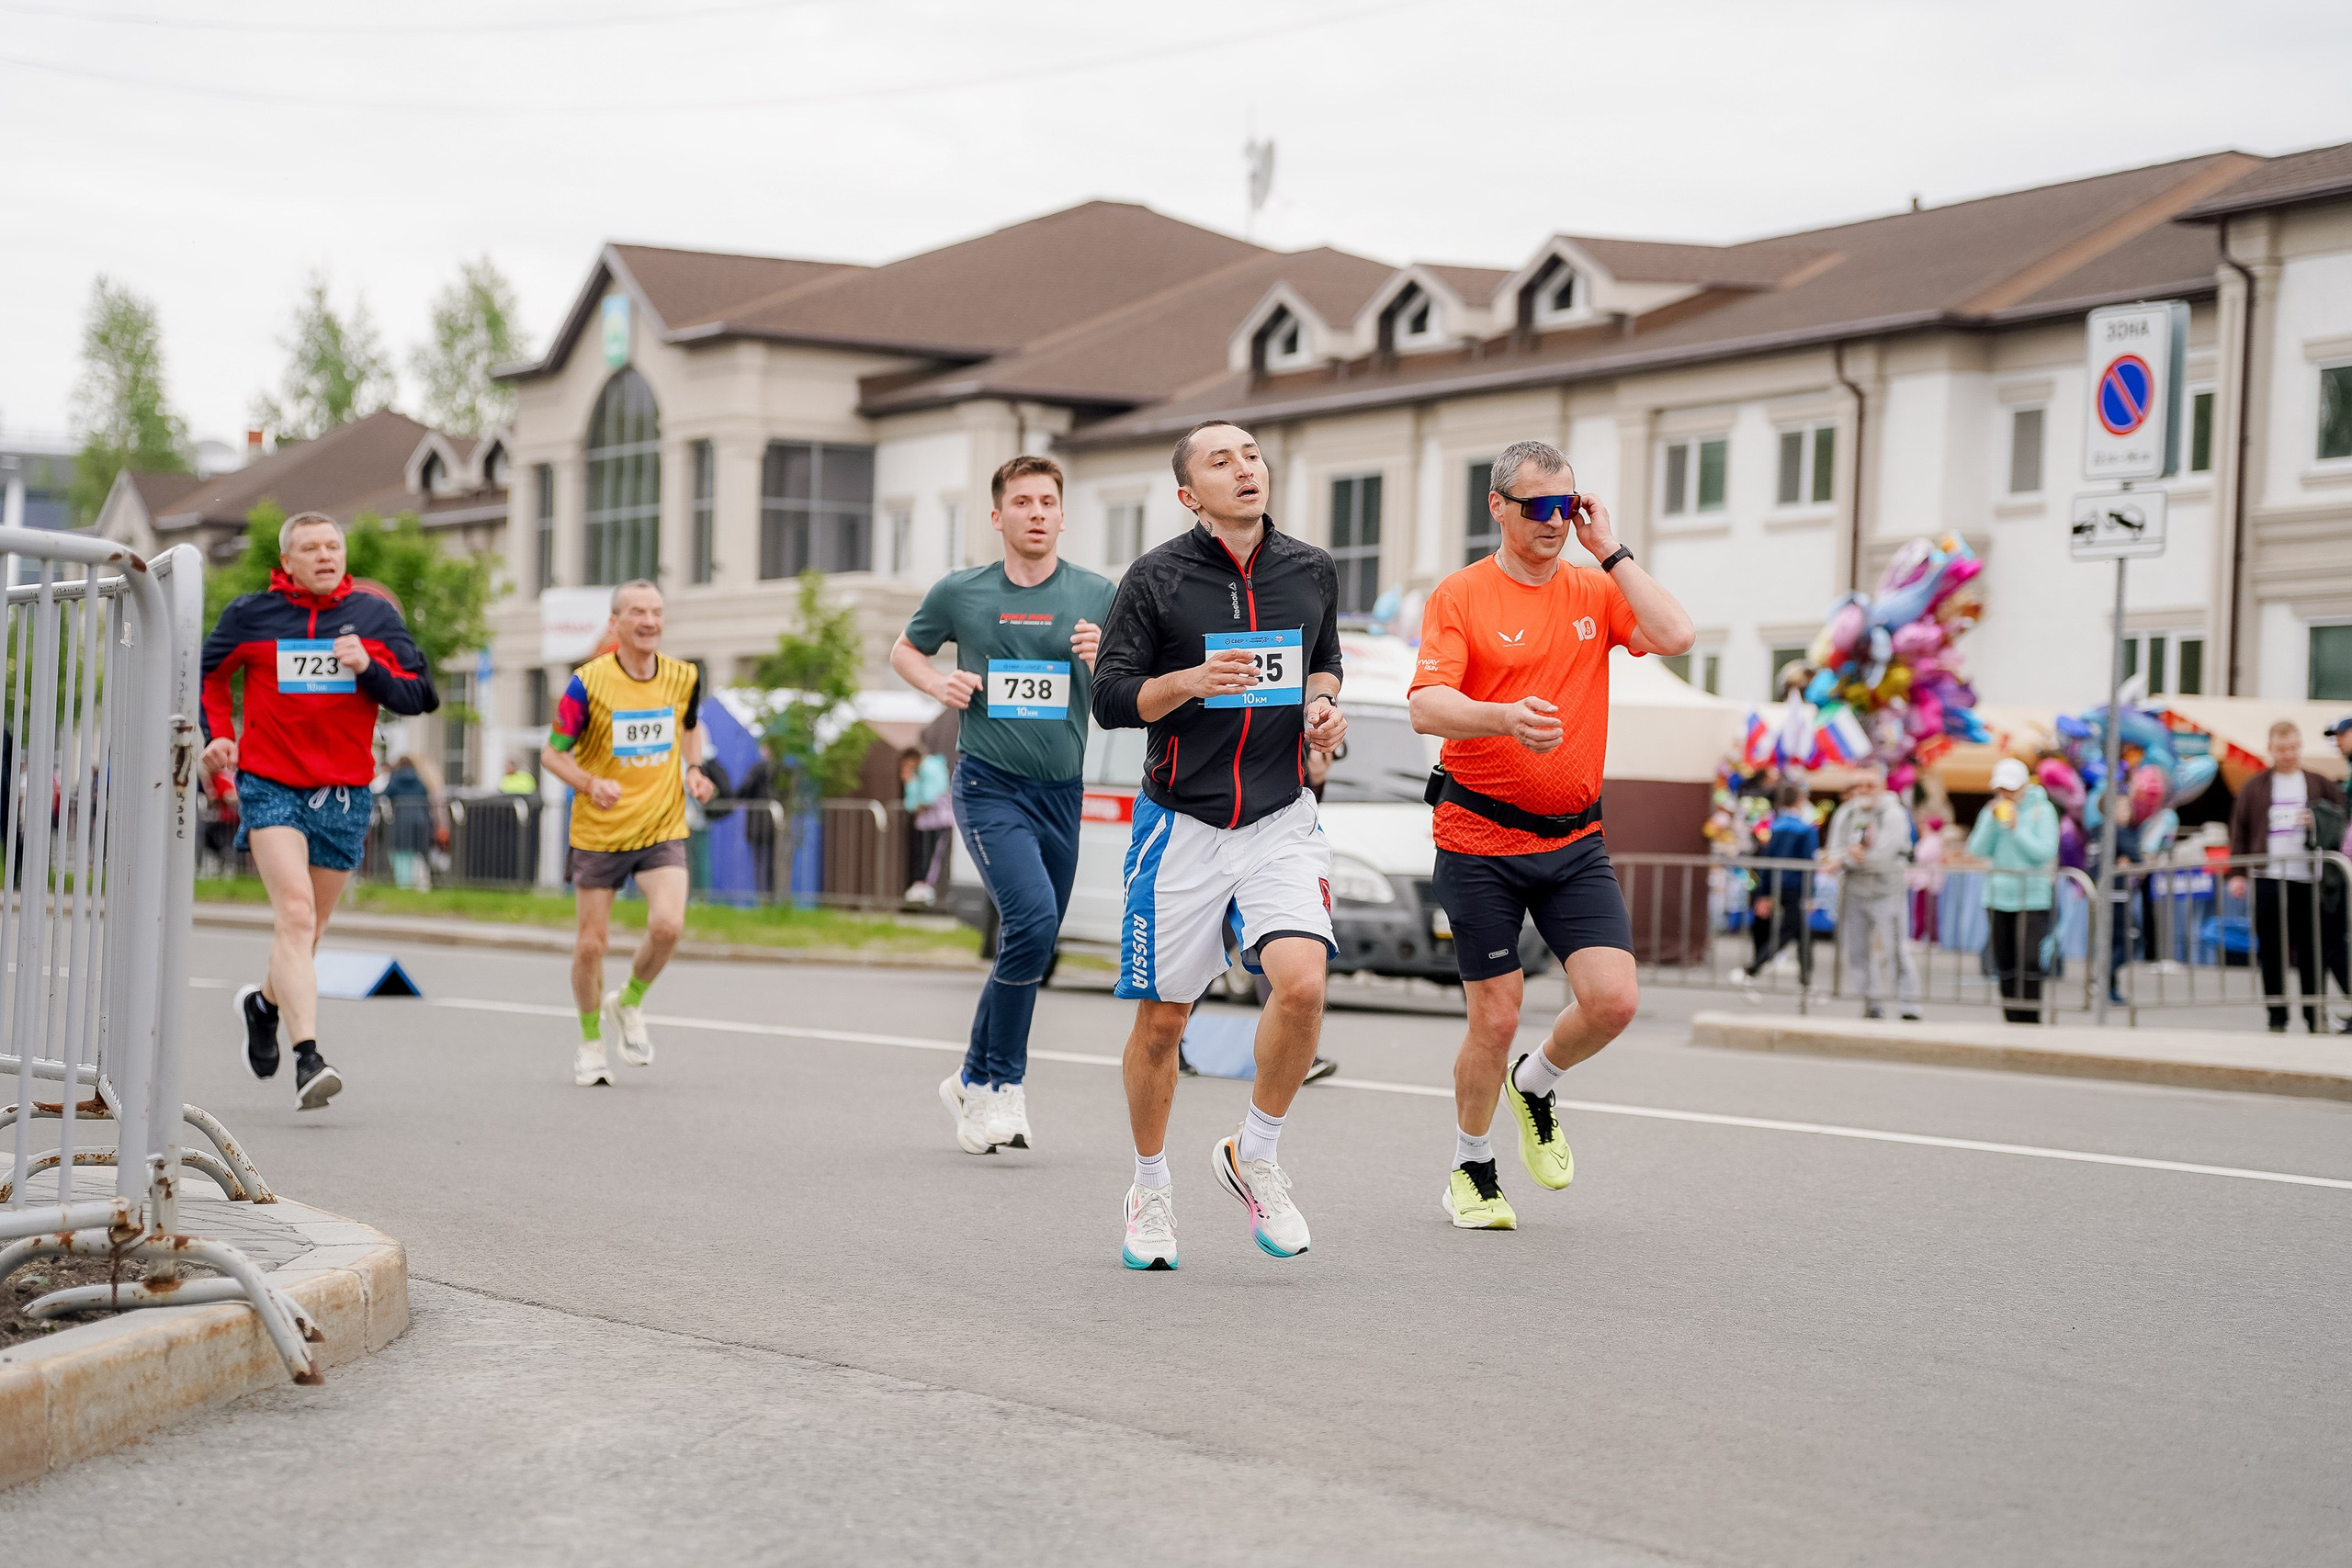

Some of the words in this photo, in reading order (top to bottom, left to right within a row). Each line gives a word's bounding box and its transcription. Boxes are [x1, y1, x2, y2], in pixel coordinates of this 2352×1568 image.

[2107, 319, 2150, 341] ЗОНА
[1231, 591, 1240, 619] Reebok
[1572, 616, 1597, 641] 10
[293, 657, 339, 675] 723
[1251, 653, 1283, 682] 25
[1004, 678, 1052, 700] 738
[1242, 693, 1255, 704] 10
[1016, 706, 1027, 716] 10
[628, 724, 662, 741] 899
[1132, 913, 1148, 989] RUSSIA
